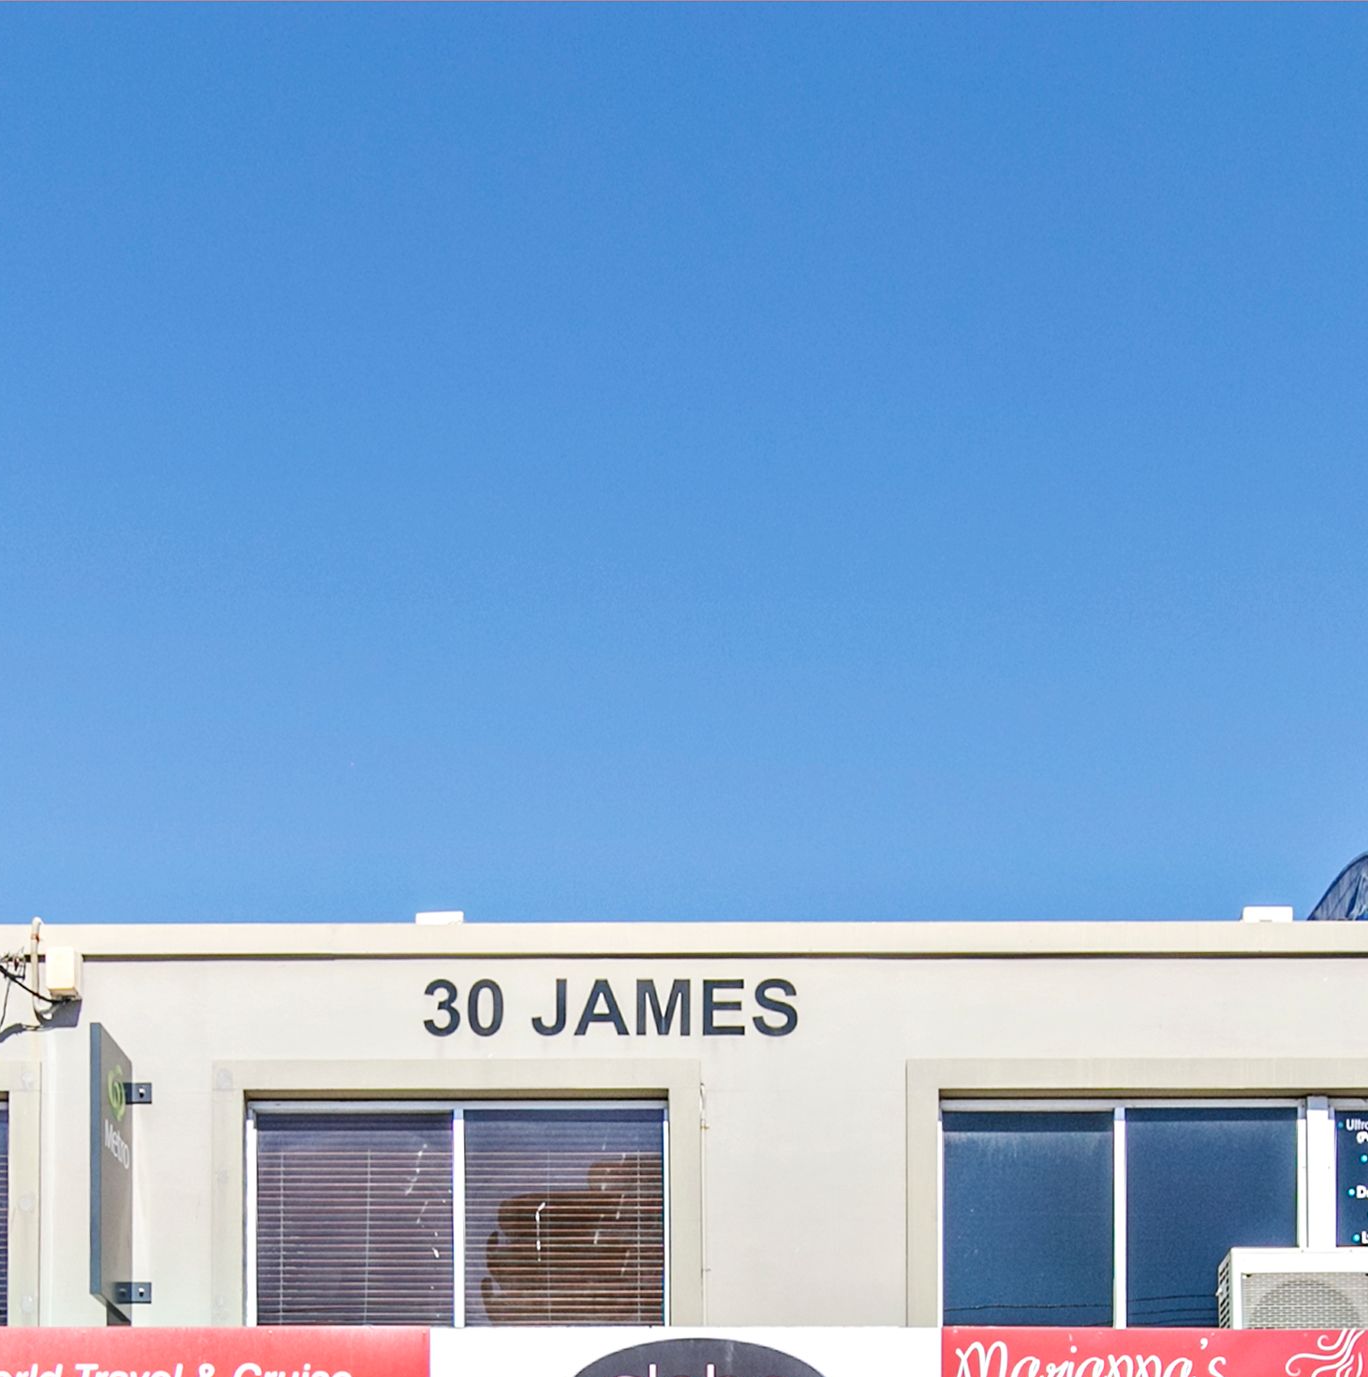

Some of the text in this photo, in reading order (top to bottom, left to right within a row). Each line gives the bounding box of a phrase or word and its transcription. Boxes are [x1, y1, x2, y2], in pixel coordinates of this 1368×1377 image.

[423, 978, 798, 1037] 30 JAMES
[104, 1119, 130, 1171] Metro
